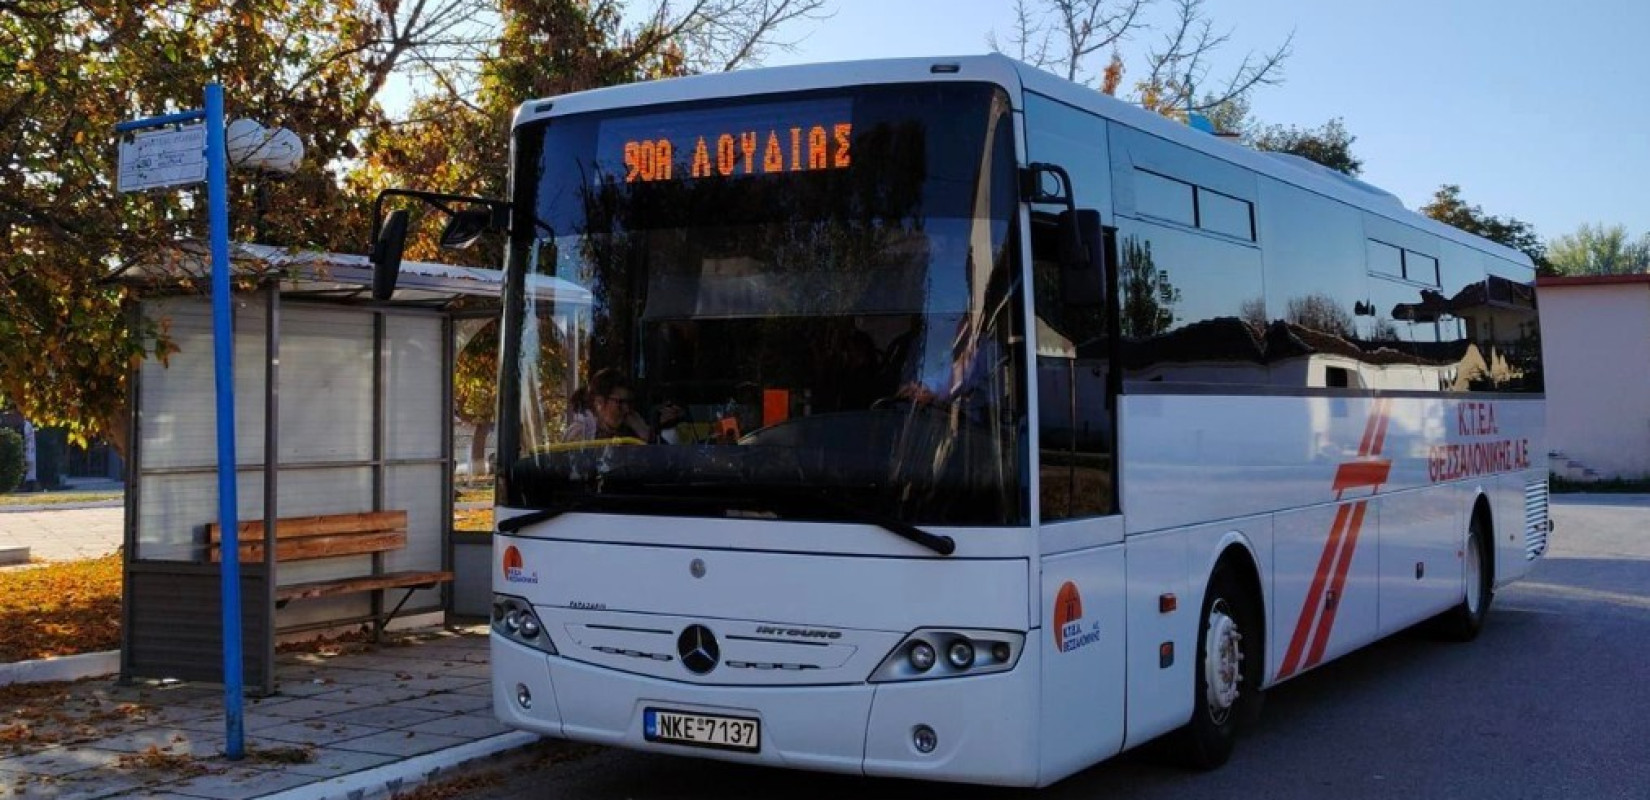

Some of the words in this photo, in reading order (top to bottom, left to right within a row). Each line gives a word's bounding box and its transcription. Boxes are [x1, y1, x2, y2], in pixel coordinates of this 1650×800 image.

[691, 123, 852, 177] ΛΟΥΔΙΑΣ
[1428, 440, 1511, 482] ΘΕΣΣΑΛΟΝΙΚΗΣ
[755, 625, 842, 639] INTOURO
